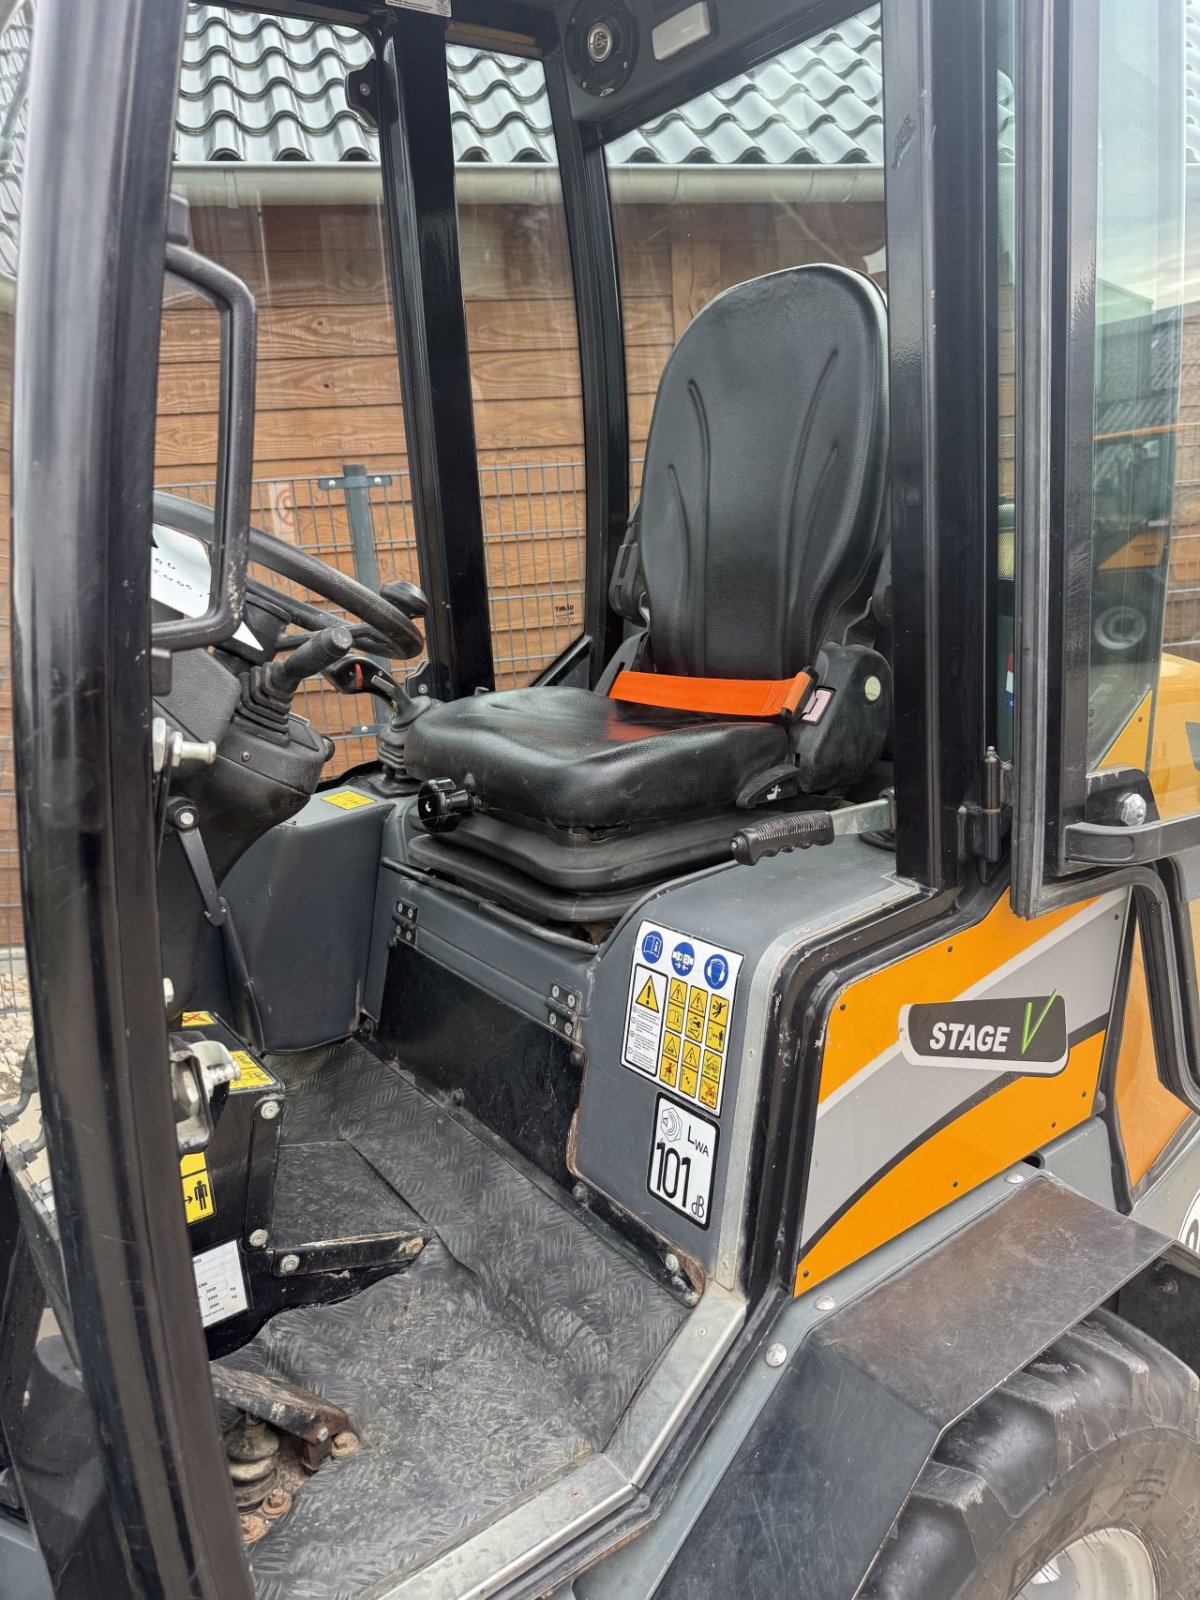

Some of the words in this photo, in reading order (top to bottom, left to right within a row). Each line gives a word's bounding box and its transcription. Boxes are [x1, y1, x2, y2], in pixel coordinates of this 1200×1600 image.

[929, 1022, 1011, 1053] STAGE
[1021, 988, 1060, 1056] V
[656, 1141, 692, 1208] 101
[691, 1195, 705, 1219] dB
